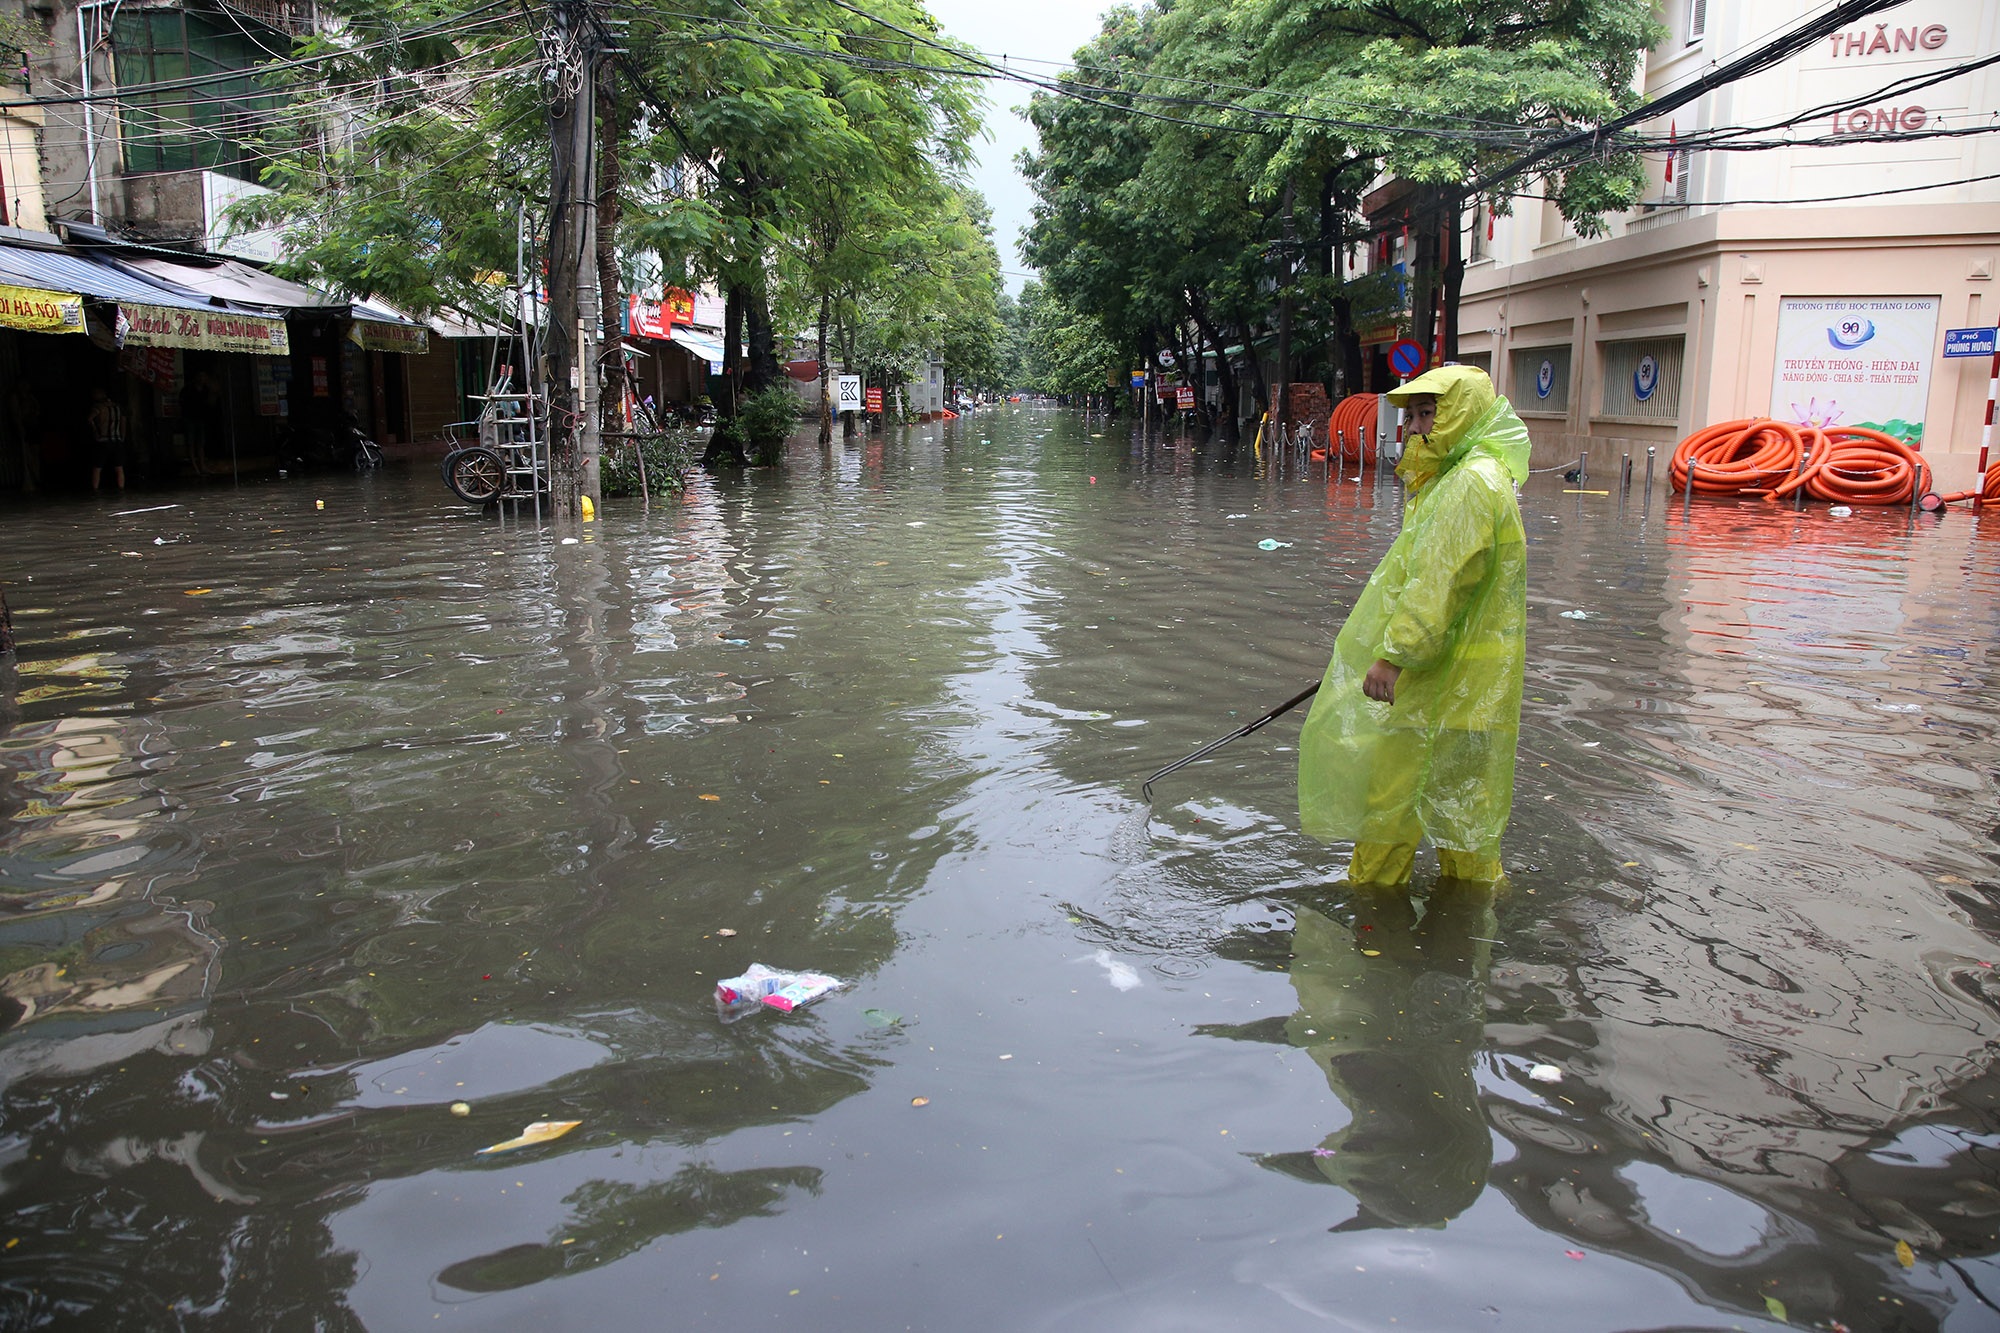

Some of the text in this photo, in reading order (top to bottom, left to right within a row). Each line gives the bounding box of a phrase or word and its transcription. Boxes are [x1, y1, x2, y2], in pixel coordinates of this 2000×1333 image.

[1830, 23, 1948, 57] THĂNG
[1833, 105, 1927, 133] LONG
[14, 297, 34, 317] HÀ
[35, 299, 60, 322] NỘI
[1849, 302, 1868, 311] HỌC
[1905, 302, 1931, 310] LONG
[1842, 322, 1859, 334] 90
[1961, 331, 1979, 340] PHỐ
[1947, 341, 1991, 353] PHÙNG HƯNG
[1901, 361, 1920, 372] ĐẠI
[1834, 374, 1852, 382] CHIA
